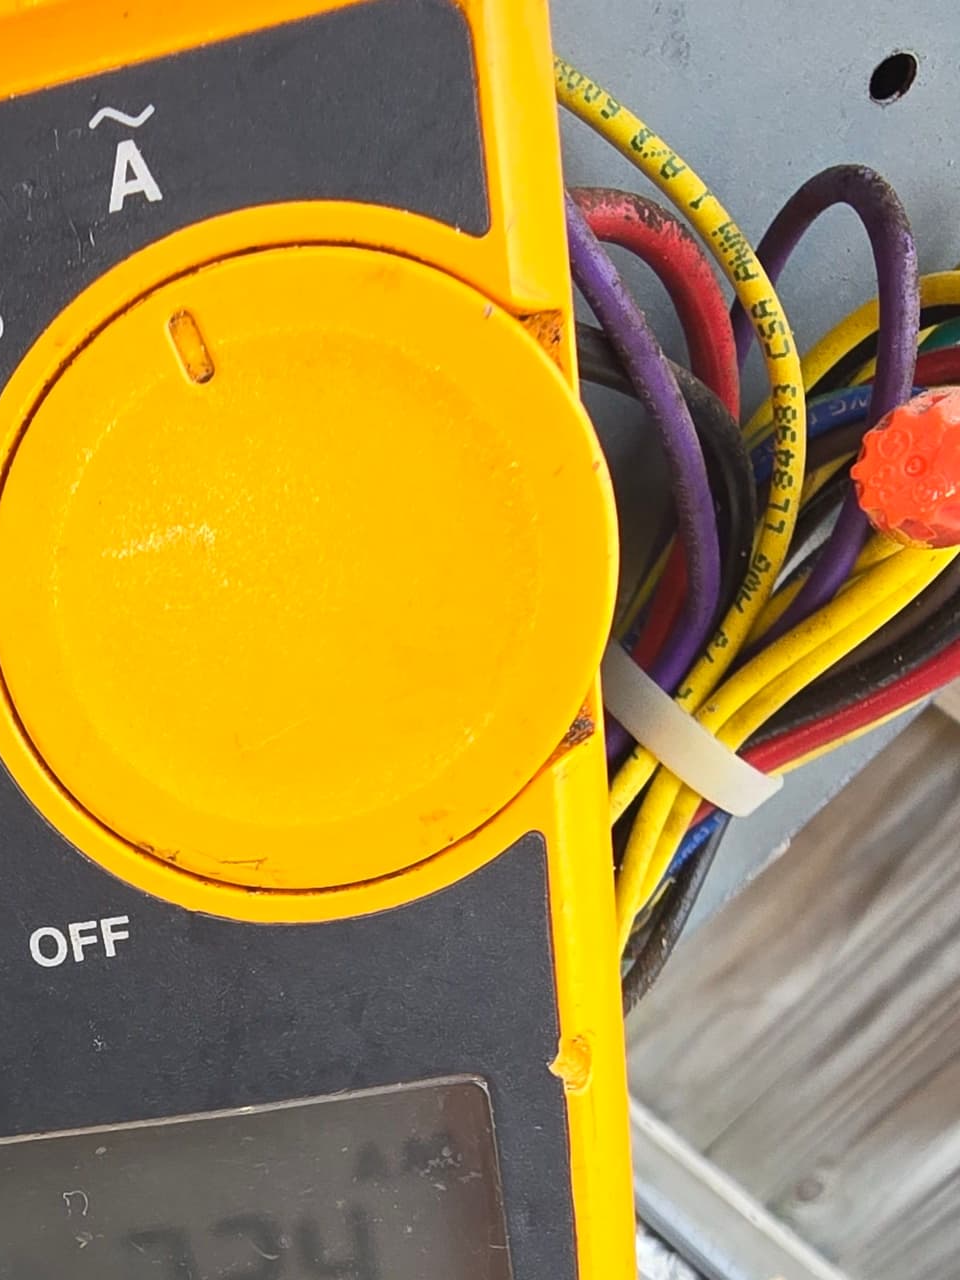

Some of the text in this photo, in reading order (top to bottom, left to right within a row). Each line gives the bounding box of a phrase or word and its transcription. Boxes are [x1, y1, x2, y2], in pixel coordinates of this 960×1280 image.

[750, 298, 791, 361] CSA
[734, 551, 772, 614] AWG
[29, 915, 130, 968] OFF
